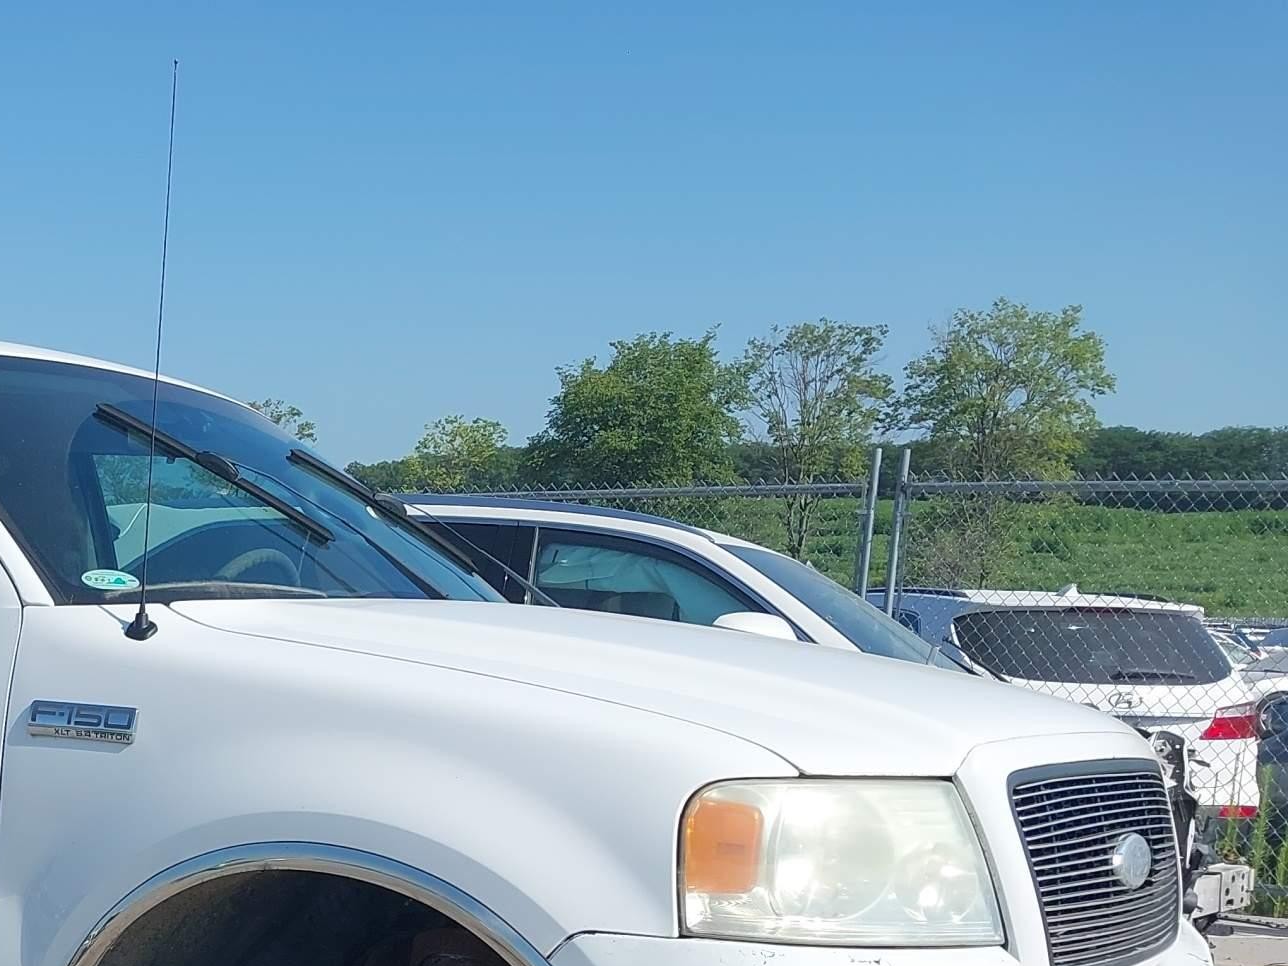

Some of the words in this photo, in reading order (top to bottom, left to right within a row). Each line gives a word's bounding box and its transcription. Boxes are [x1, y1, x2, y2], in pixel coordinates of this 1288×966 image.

[30, 699, 136, 730] F-150
[54, 728, 71, 737] XLT
[93, 731, 132, 742] TRITON
